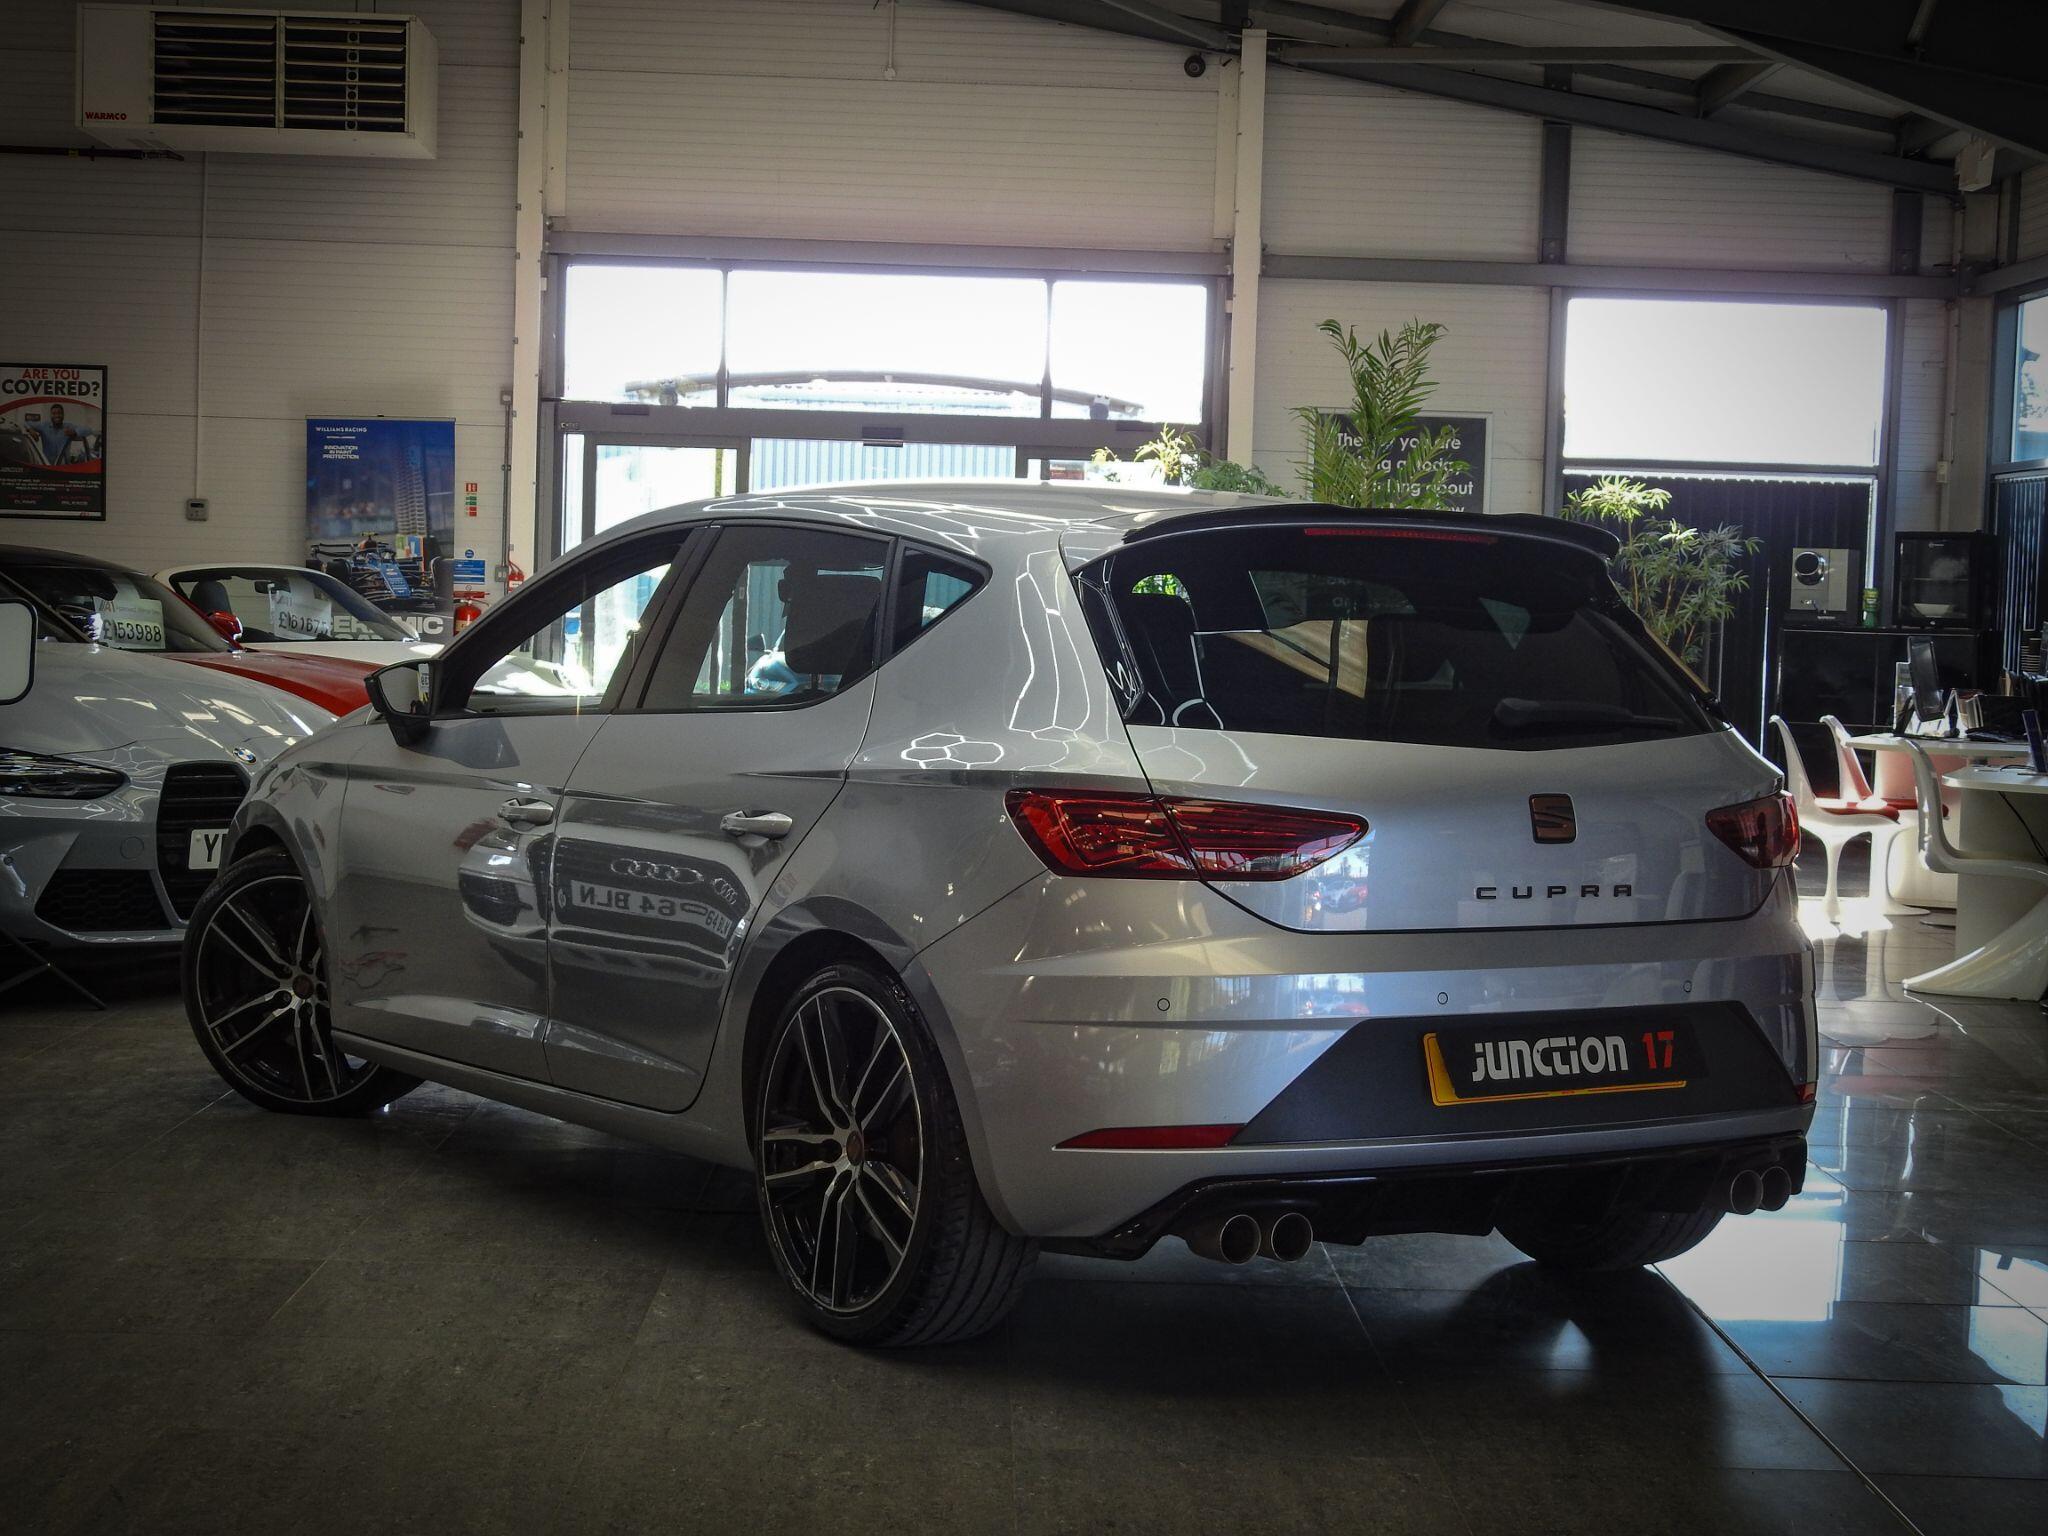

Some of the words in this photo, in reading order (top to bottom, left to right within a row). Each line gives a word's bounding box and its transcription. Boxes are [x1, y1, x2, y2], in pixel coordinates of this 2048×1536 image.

[85, 111, 127, 121] WARMCO
[22, 368, 49, 380] ARE
[53, 369, 80, 381] YOU
[2, 379, 100, 397] COVERED?
[1337, 432, 1363, 447] The
[1475, 884, 1633, 900] CUPRA
[1642, 1030, 1675, 1070] 17
